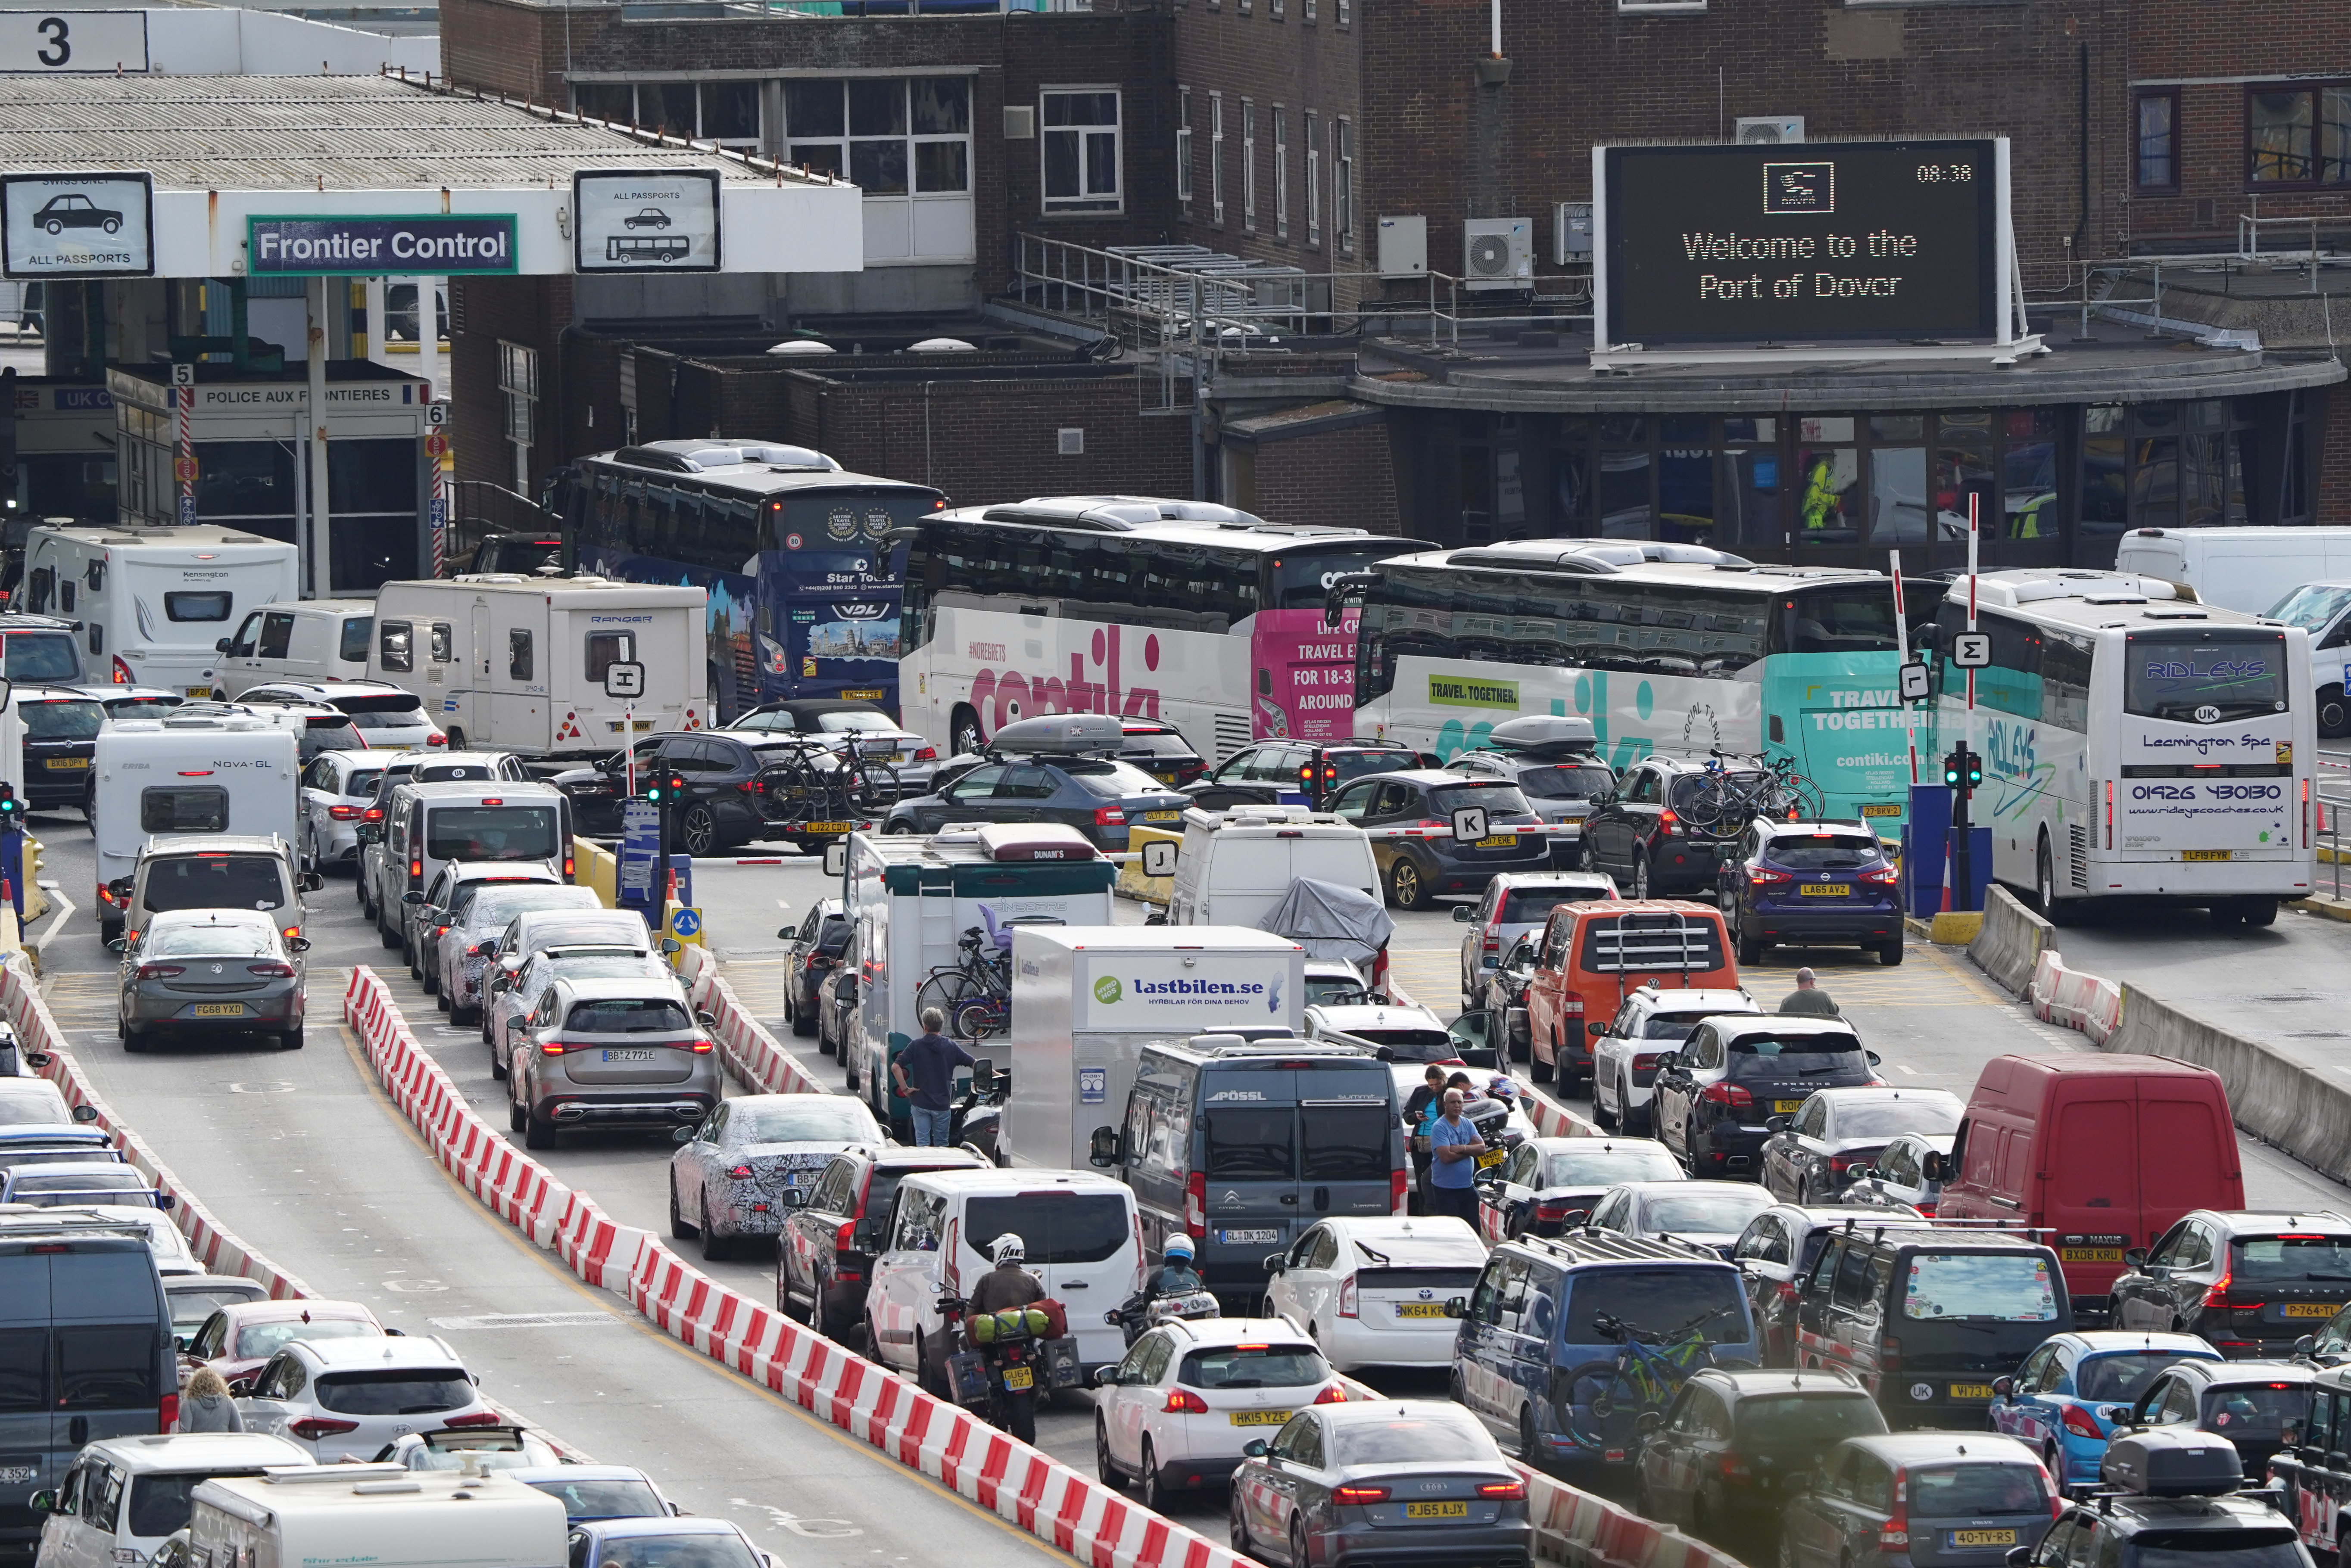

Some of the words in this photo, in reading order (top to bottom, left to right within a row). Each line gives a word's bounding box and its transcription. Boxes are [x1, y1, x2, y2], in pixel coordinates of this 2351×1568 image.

[38, 18, 71, 66] 3
[1918, 165, 1971, 182] 08:38
[260, 233, 381, 259] Frontier
[392, 231, 505, 258] Control
[1683, 233, 1814, 260] Welcome
[1826, 234, 1855, 257] to
[1868, 230, 1917, 256] the
[29, 255, 52, 264] ALL
[56, 254, 131, 264] PASSPORTS
[1701, 274, 1762, 299] Port
[1774, 274, 1803, 299] of
[177, 365, 189, 383] 5
[68, 392, 92, 406] UK
[207, 392, 261, 404] POLICE
[266, 392, 293, 403] AUX
[299, 389, 390, 403] FNTIERES
[430, 406, 443, 423] 6
[183, 460, 192, 478] STOP
[183, 571, 228, 580] Kensington
[827, 573, 855, 584] Star
[841, 604, 879, 615] VDL
[969, 641, 1006, 662] #NOREGRETS
[1298, 644, 1344, 659] TRAVEL
[2147, 661, 2266, 678] RIDLEYS
[1294, 670, 1319, 685] FOR
[1431, 682, 1466, 699] TRAVEL.
[1468, 685, 1517, 703] TOGETHER.
[1299, 694, 1353, 709] AROUND
[2199, 709, 2217, 719] UK
[635, 722, 649, 730] NNM
[1988, 716, 2035, 780] RIDLEYS
[2144, 734, 2235, 755] Leamington
[2241, 734, 2270, 750] Spa
[454, 768, 464, 777] UK
[2133, 786, 2196, 800] 01926
[2206, 785, 2281, 799] 430130
[810, 822, 829, 832] LJ22
[832, 823, 847, 831] CDY
[1464, 816, 1478, 832] K
[1156, 852, 1163, 867] J
[2189, 852, 2209, 860] LF19
[2211, 851, 2227, 859] FYR
[1804, 884, 1826, 893] LA65
[1829, 884, 1846, 892] AVZ
[1097, 980, 1118, 996] HYRD
[1134, 979, 1264, 994] lastbilen.se
[1100, 987, 1118, 1000] HOS
[196, 1005, 219, 1015] FG68
[223, 1004, 242, 1014] YXD
[1219, 1090, 1266, 1101] PÖSSL
[797, 1175, 810, 1183] BB
[1226, 1230, 1237, 1240] GL
[1243, 1230, 1254, 1240] DK
[1257, 1229, 1276, 1240] 1204
[2089, 1235, 2122, 1244] MAXUS
[2098, 1248, 2117, 1259] KRU
[1400, 1305, 1428, 1316] NK64
[1914, 1387, 1930, 1397] UK
[1958, 1385, 1982, 1396] V173
[1236, 1412, 1261, 1422] HK15
[1264, 1412, 1285, 1421] YZE
[8, 1468, 28, 1479] 352
[1409, 1504, 1439, 1515] RJ65
[1443, 1503, 1464, 1514] AJX
[1958, 1531, 2011, 1544] 40-TV-RS
